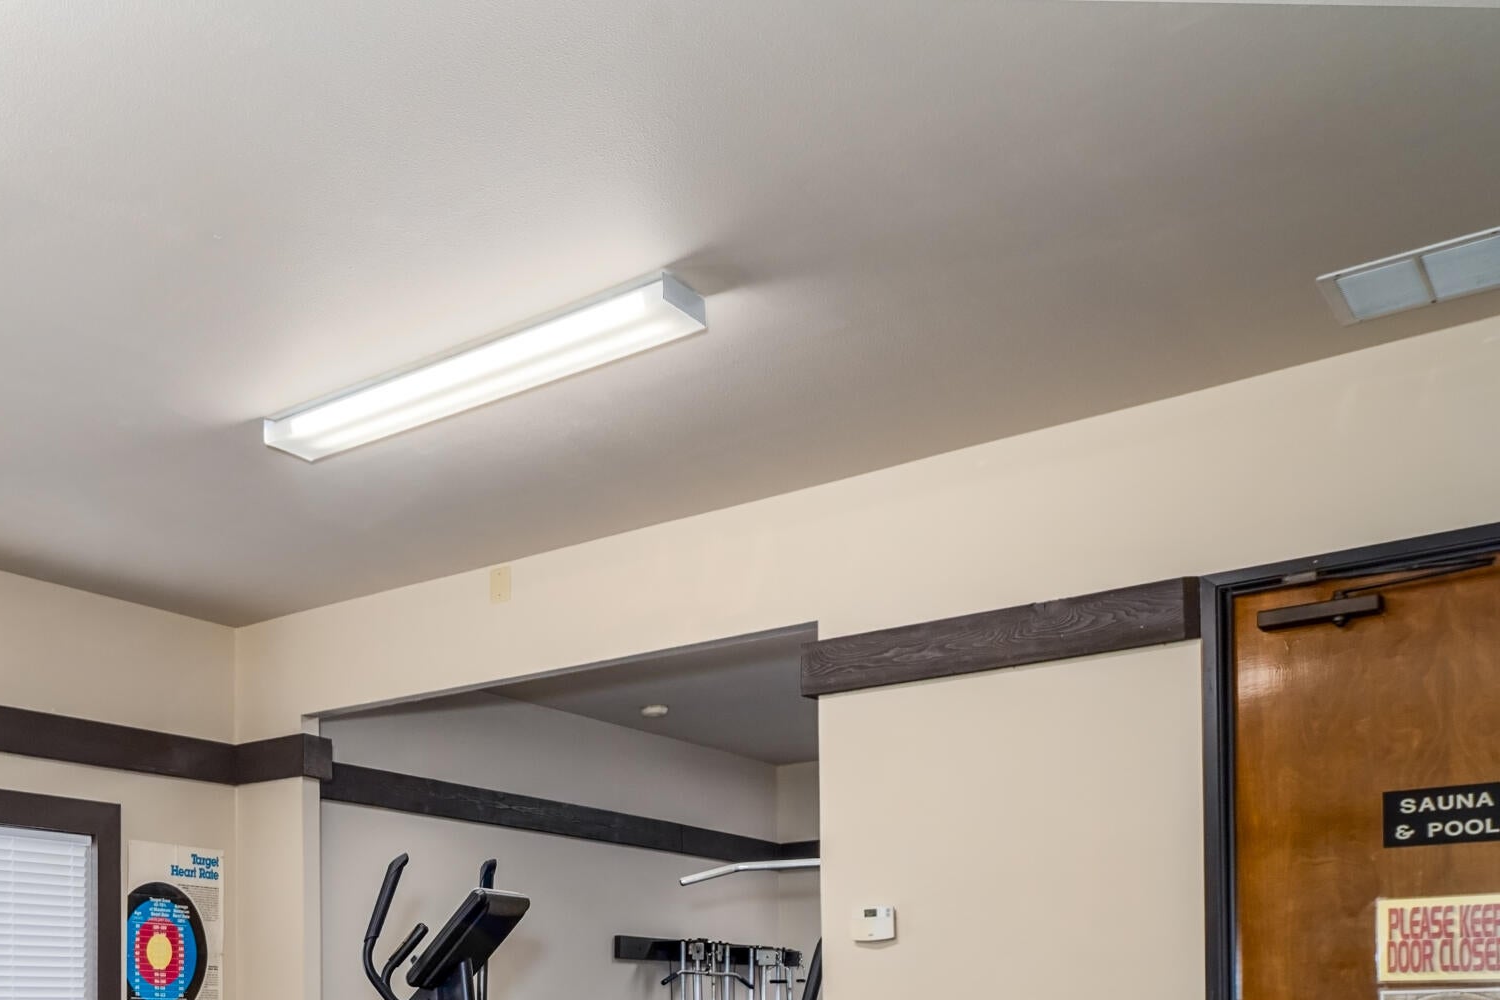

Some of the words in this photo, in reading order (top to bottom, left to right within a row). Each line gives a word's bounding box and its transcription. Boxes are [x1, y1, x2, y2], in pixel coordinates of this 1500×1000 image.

[1400, 791, 1494, 814] SAUNA
[1395, 824, 1415, 840] &
[1427, 817, 1500, 838] POOL
[171, 864, 197, 878] Heart
[199, 867, 219, 880] Rate
[191, 853, 219, 869] Target
[1388, 905, 1454, 940] PLEASE
[1387, 940, 1434, 973] DOOR
